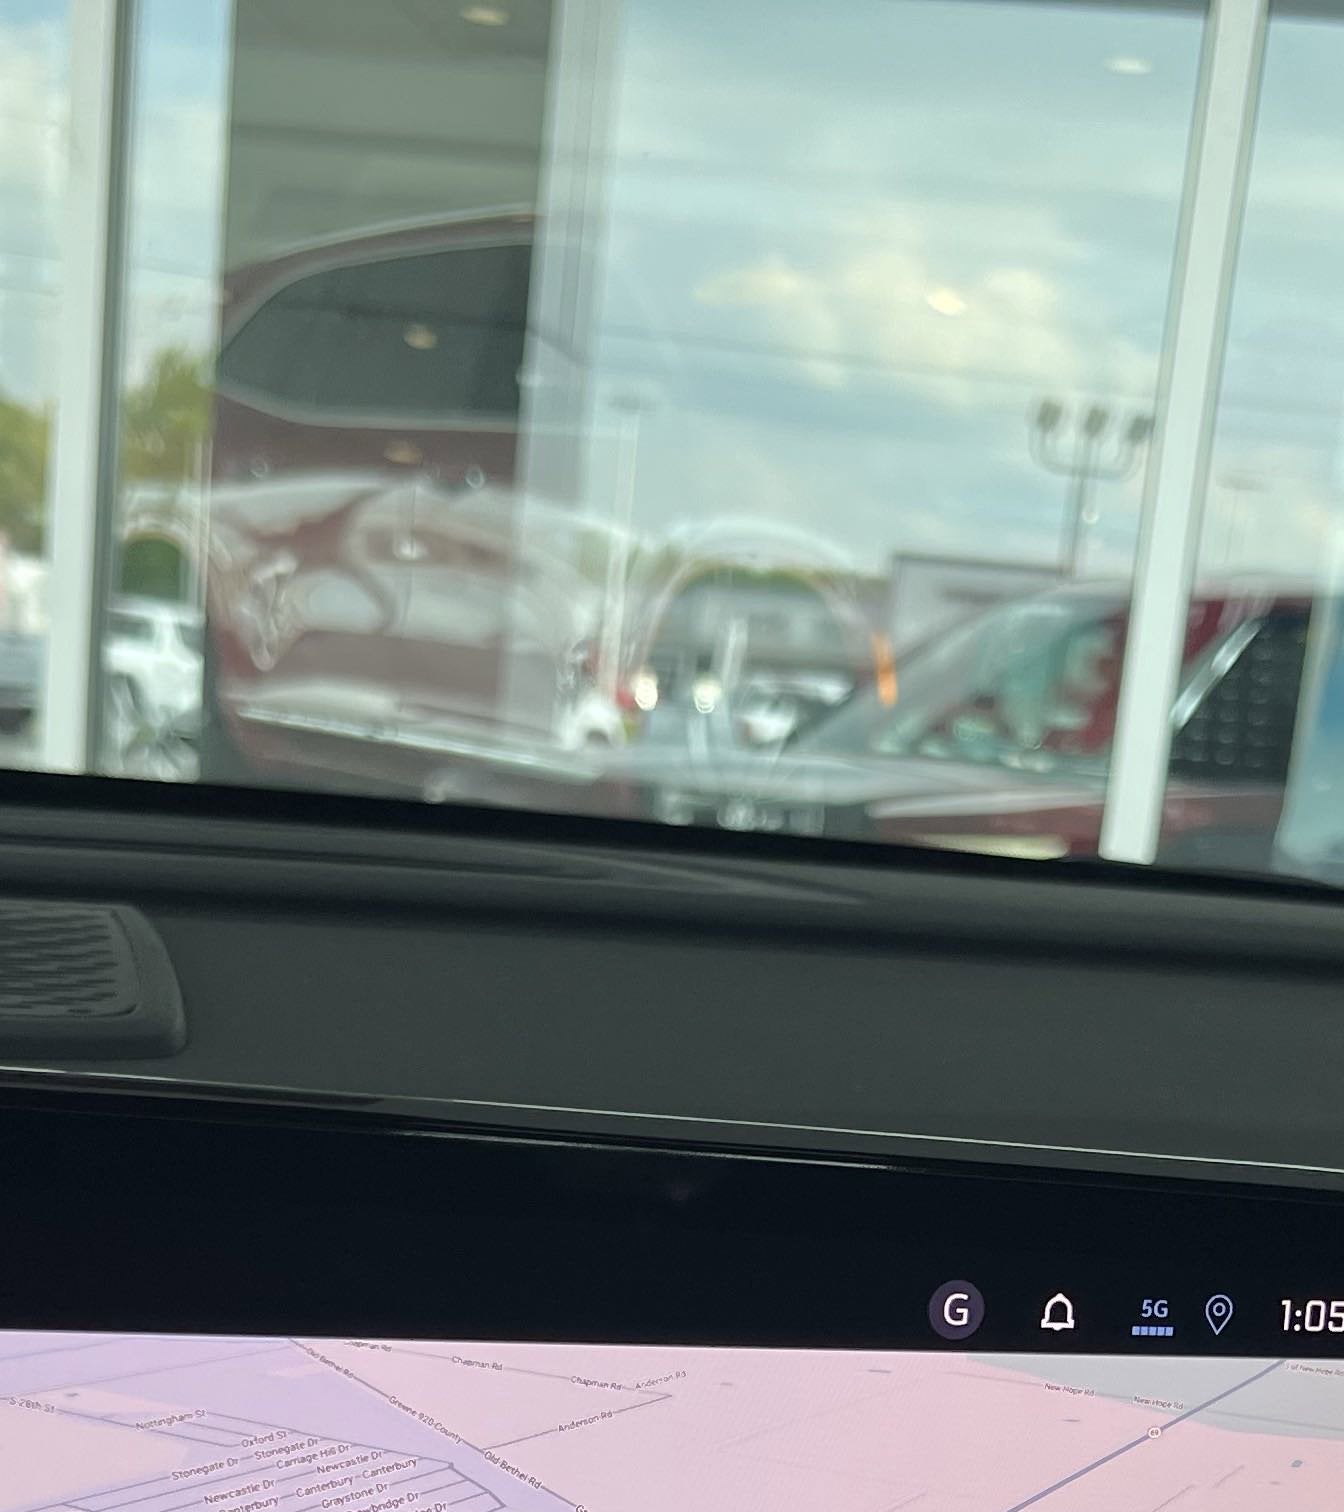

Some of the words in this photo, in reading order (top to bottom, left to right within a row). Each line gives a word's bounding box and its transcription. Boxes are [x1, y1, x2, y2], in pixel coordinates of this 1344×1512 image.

[944, 1294, 969, 1326] G
[1142, 1300, 1168, 1318] 5G
[558, 1415, 599, 1432] Anderson
[601, 1410, 613, 1420] Rd
[241, 1434, 274, 1449] Oxford
[275, 1430, 287, 1440] St
[254, 1442, 306, 1460] Stonegate
[307, 1437, 319, 1447] Dr
[338, 1443, 350, 1453] Dr
[171, 1462, 225, 1481] Stonegate
[226, 1457, 239, 1467] Dr
[317, 1454, 369, 1474] Newcastle
[370, 1449, 383, 1460] Dr
[362, 1458, 417, 1479] Canterbury
[500, 1461, 529, 1483] Bethel
[528, 1476, 542, 1489] Rd
[204, 1484, 261, 1505] Newcastle
[262, 1478, 276, 1488] Dr
[296, 1476, 353, 1497] Canterbury
[321, 1487, 375, 1509] Graystone
[376, 1482, 389, 1493] Dr
[406, 1491, 419, 1502] Dr
[433, 1502, 447, 1512] Dr
